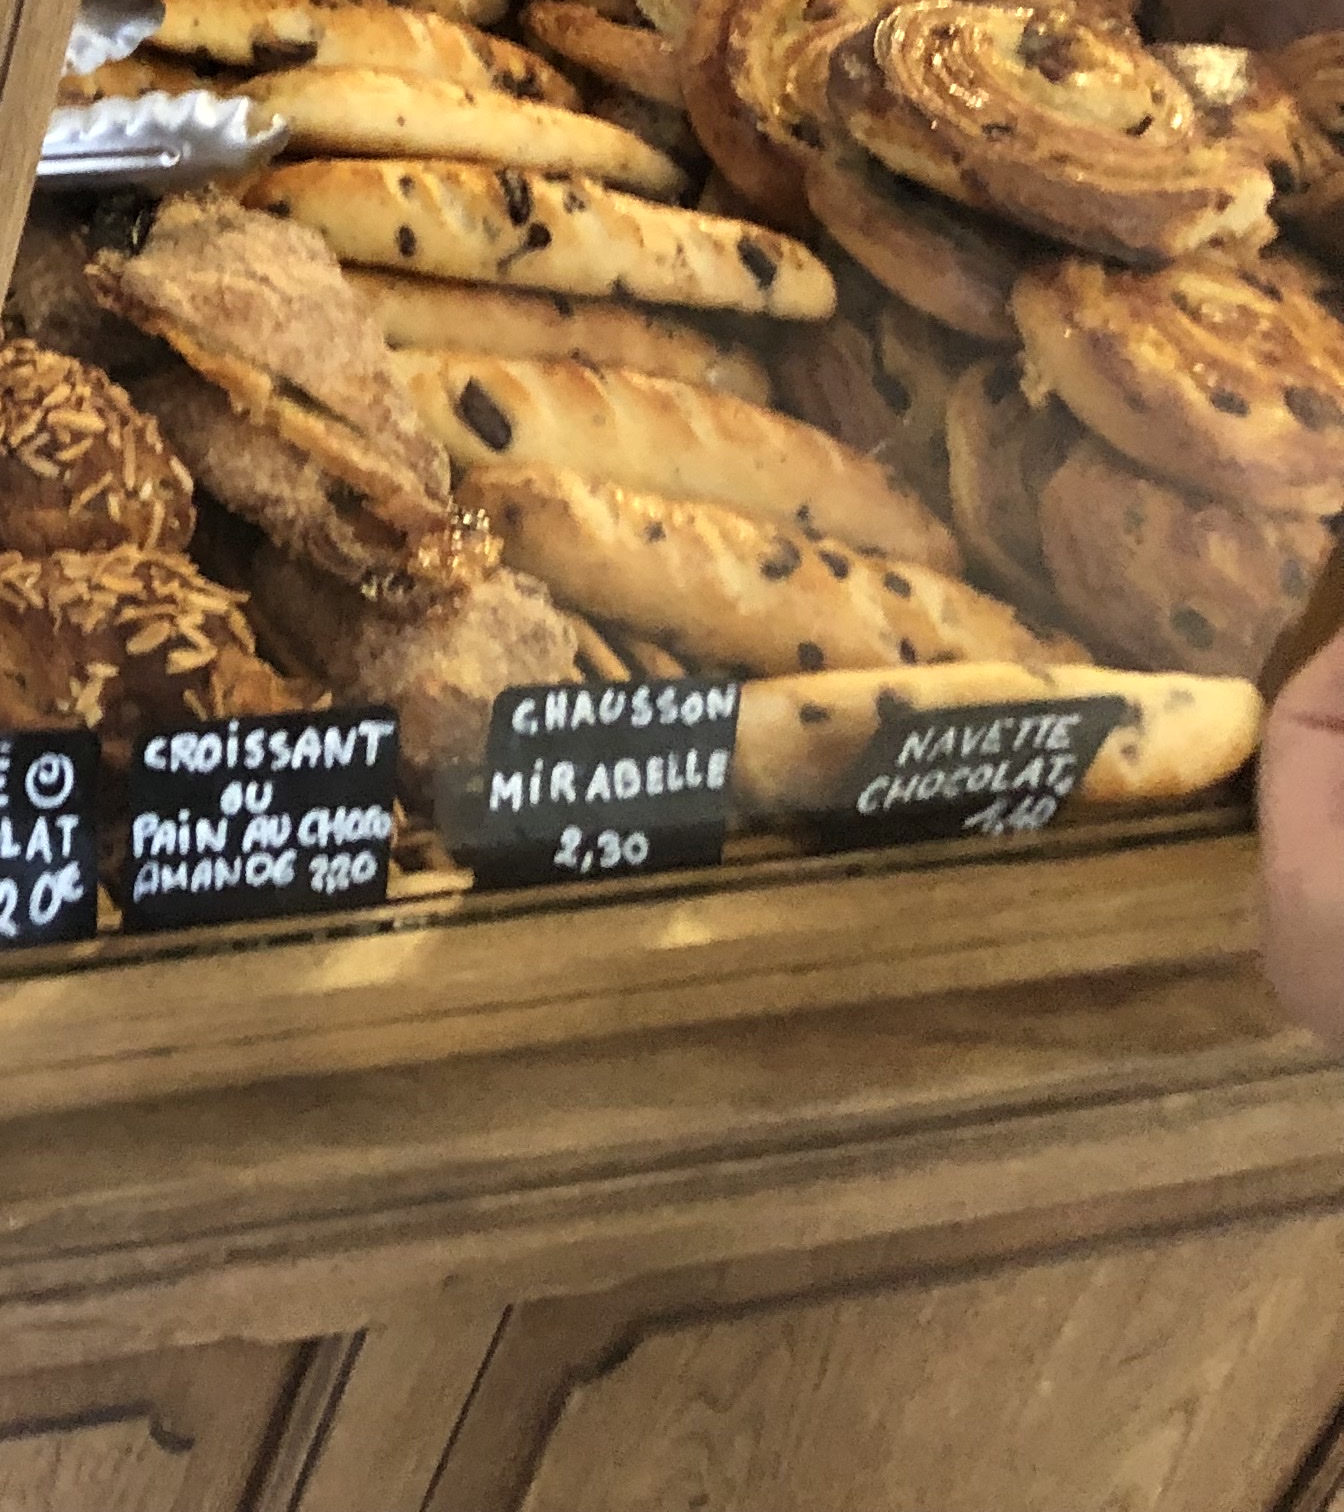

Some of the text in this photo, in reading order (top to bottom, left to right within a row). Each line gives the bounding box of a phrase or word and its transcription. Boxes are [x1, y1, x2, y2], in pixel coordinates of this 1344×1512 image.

[512, 682, 737, 735] CHAUSSON
[894, 712, 1082, 768] NAVETTE
[220, 780, 273, 816] OU
[857, 753, 1077, 815] CHOCOLAT
[242, 812, 292, 853] AU
[553, 824, 650, 874] 2,30
